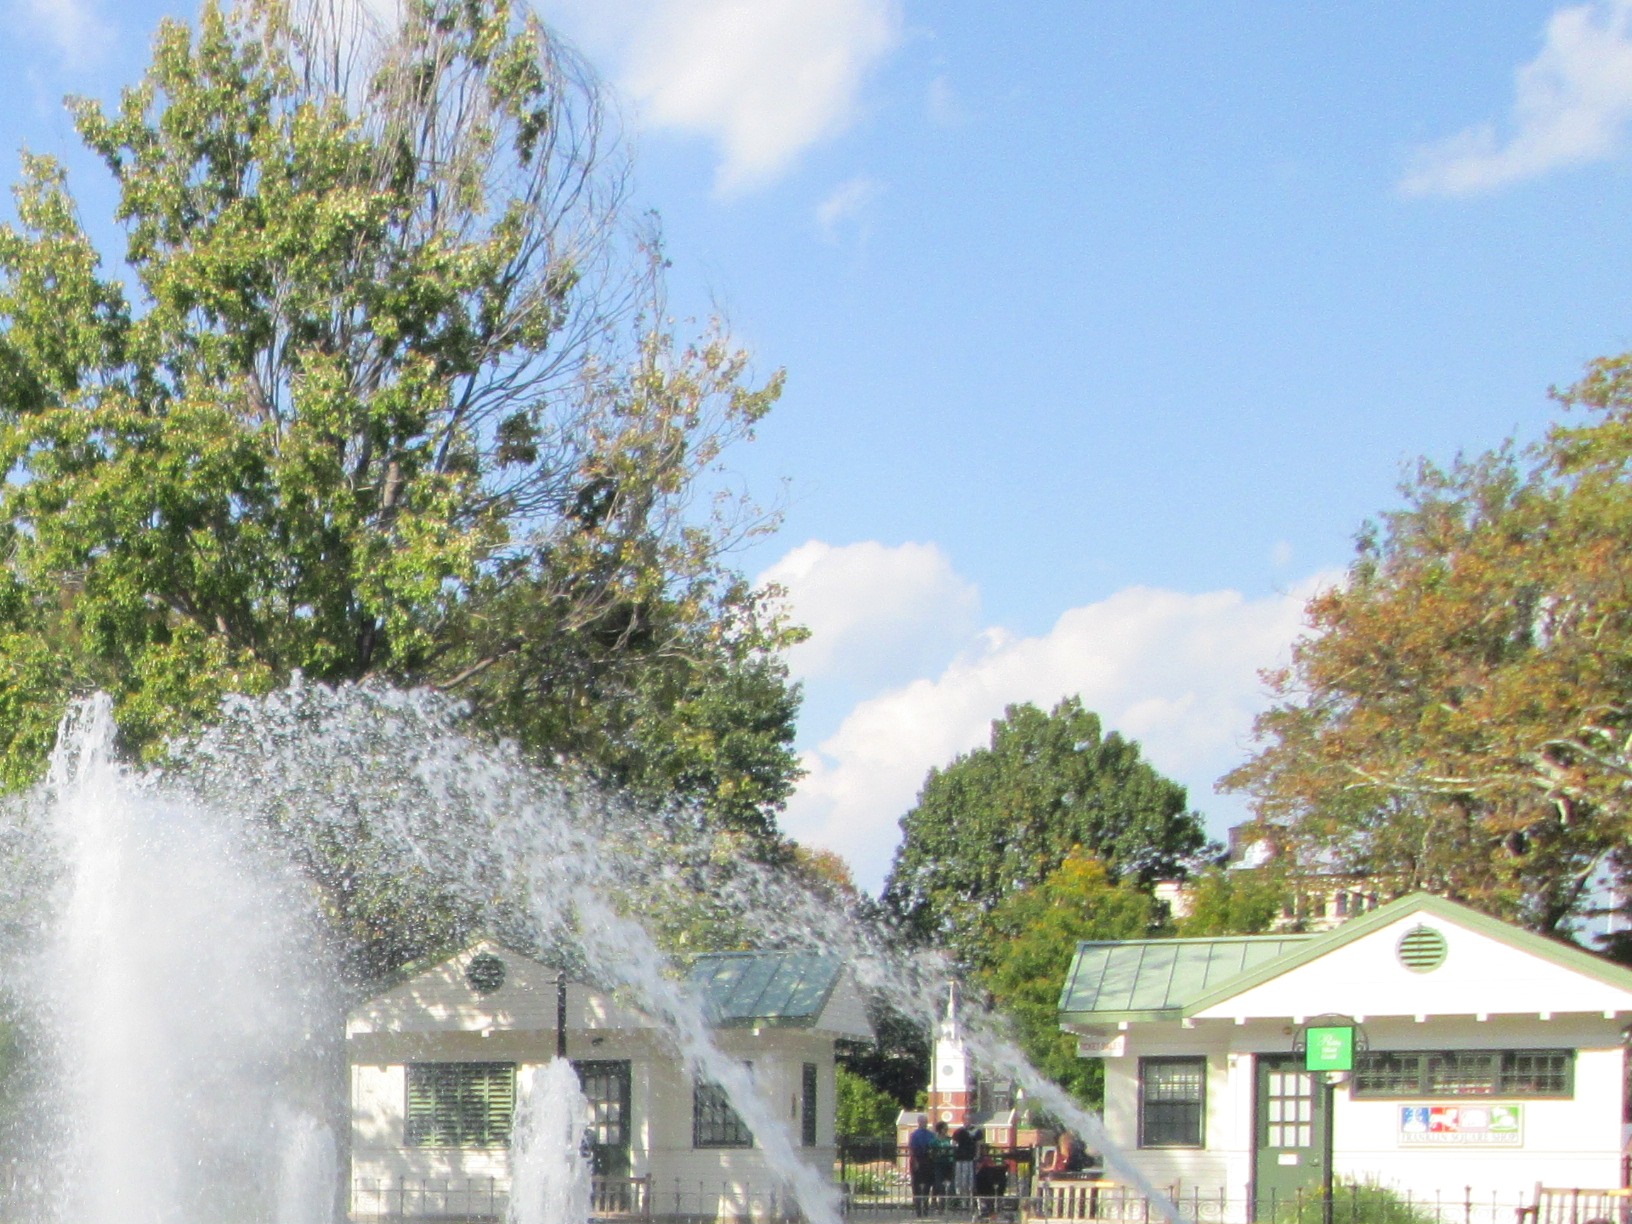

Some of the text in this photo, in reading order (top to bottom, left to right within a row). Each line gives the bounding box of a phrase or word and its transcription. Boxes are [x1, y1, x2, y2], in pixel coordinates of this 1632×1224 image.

[1402, 1132, 1518, 1143] FRANKLIN SQUARE SHOP
